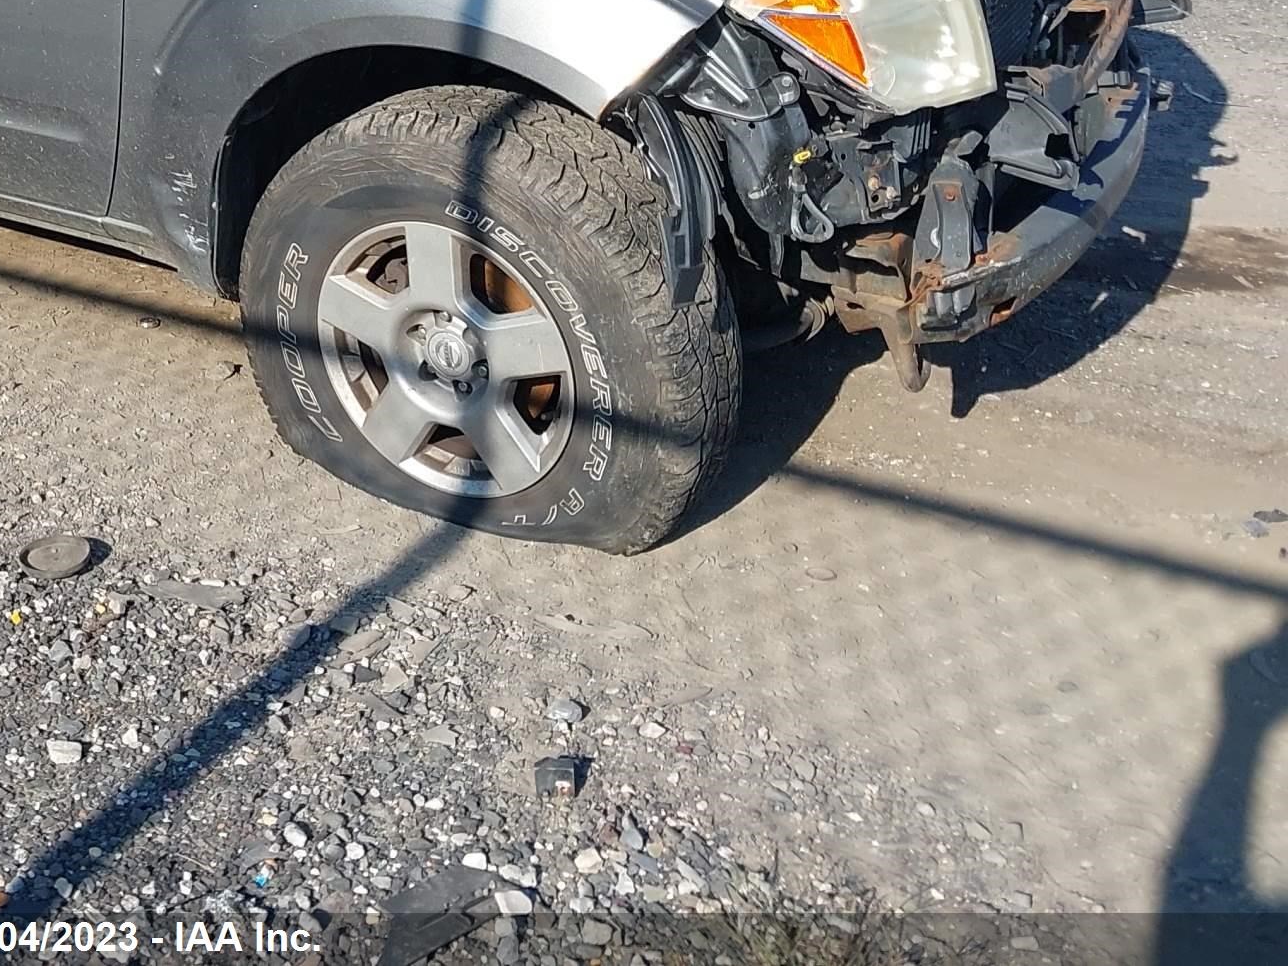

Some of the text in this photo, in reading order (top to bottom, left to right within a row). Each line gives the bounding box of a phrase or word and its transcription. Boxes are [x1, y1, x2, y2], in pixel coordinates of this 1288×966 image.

[276, 242, 344, 443] COOPER
[445, 200, 613, 526] DISCOVERER A/T
